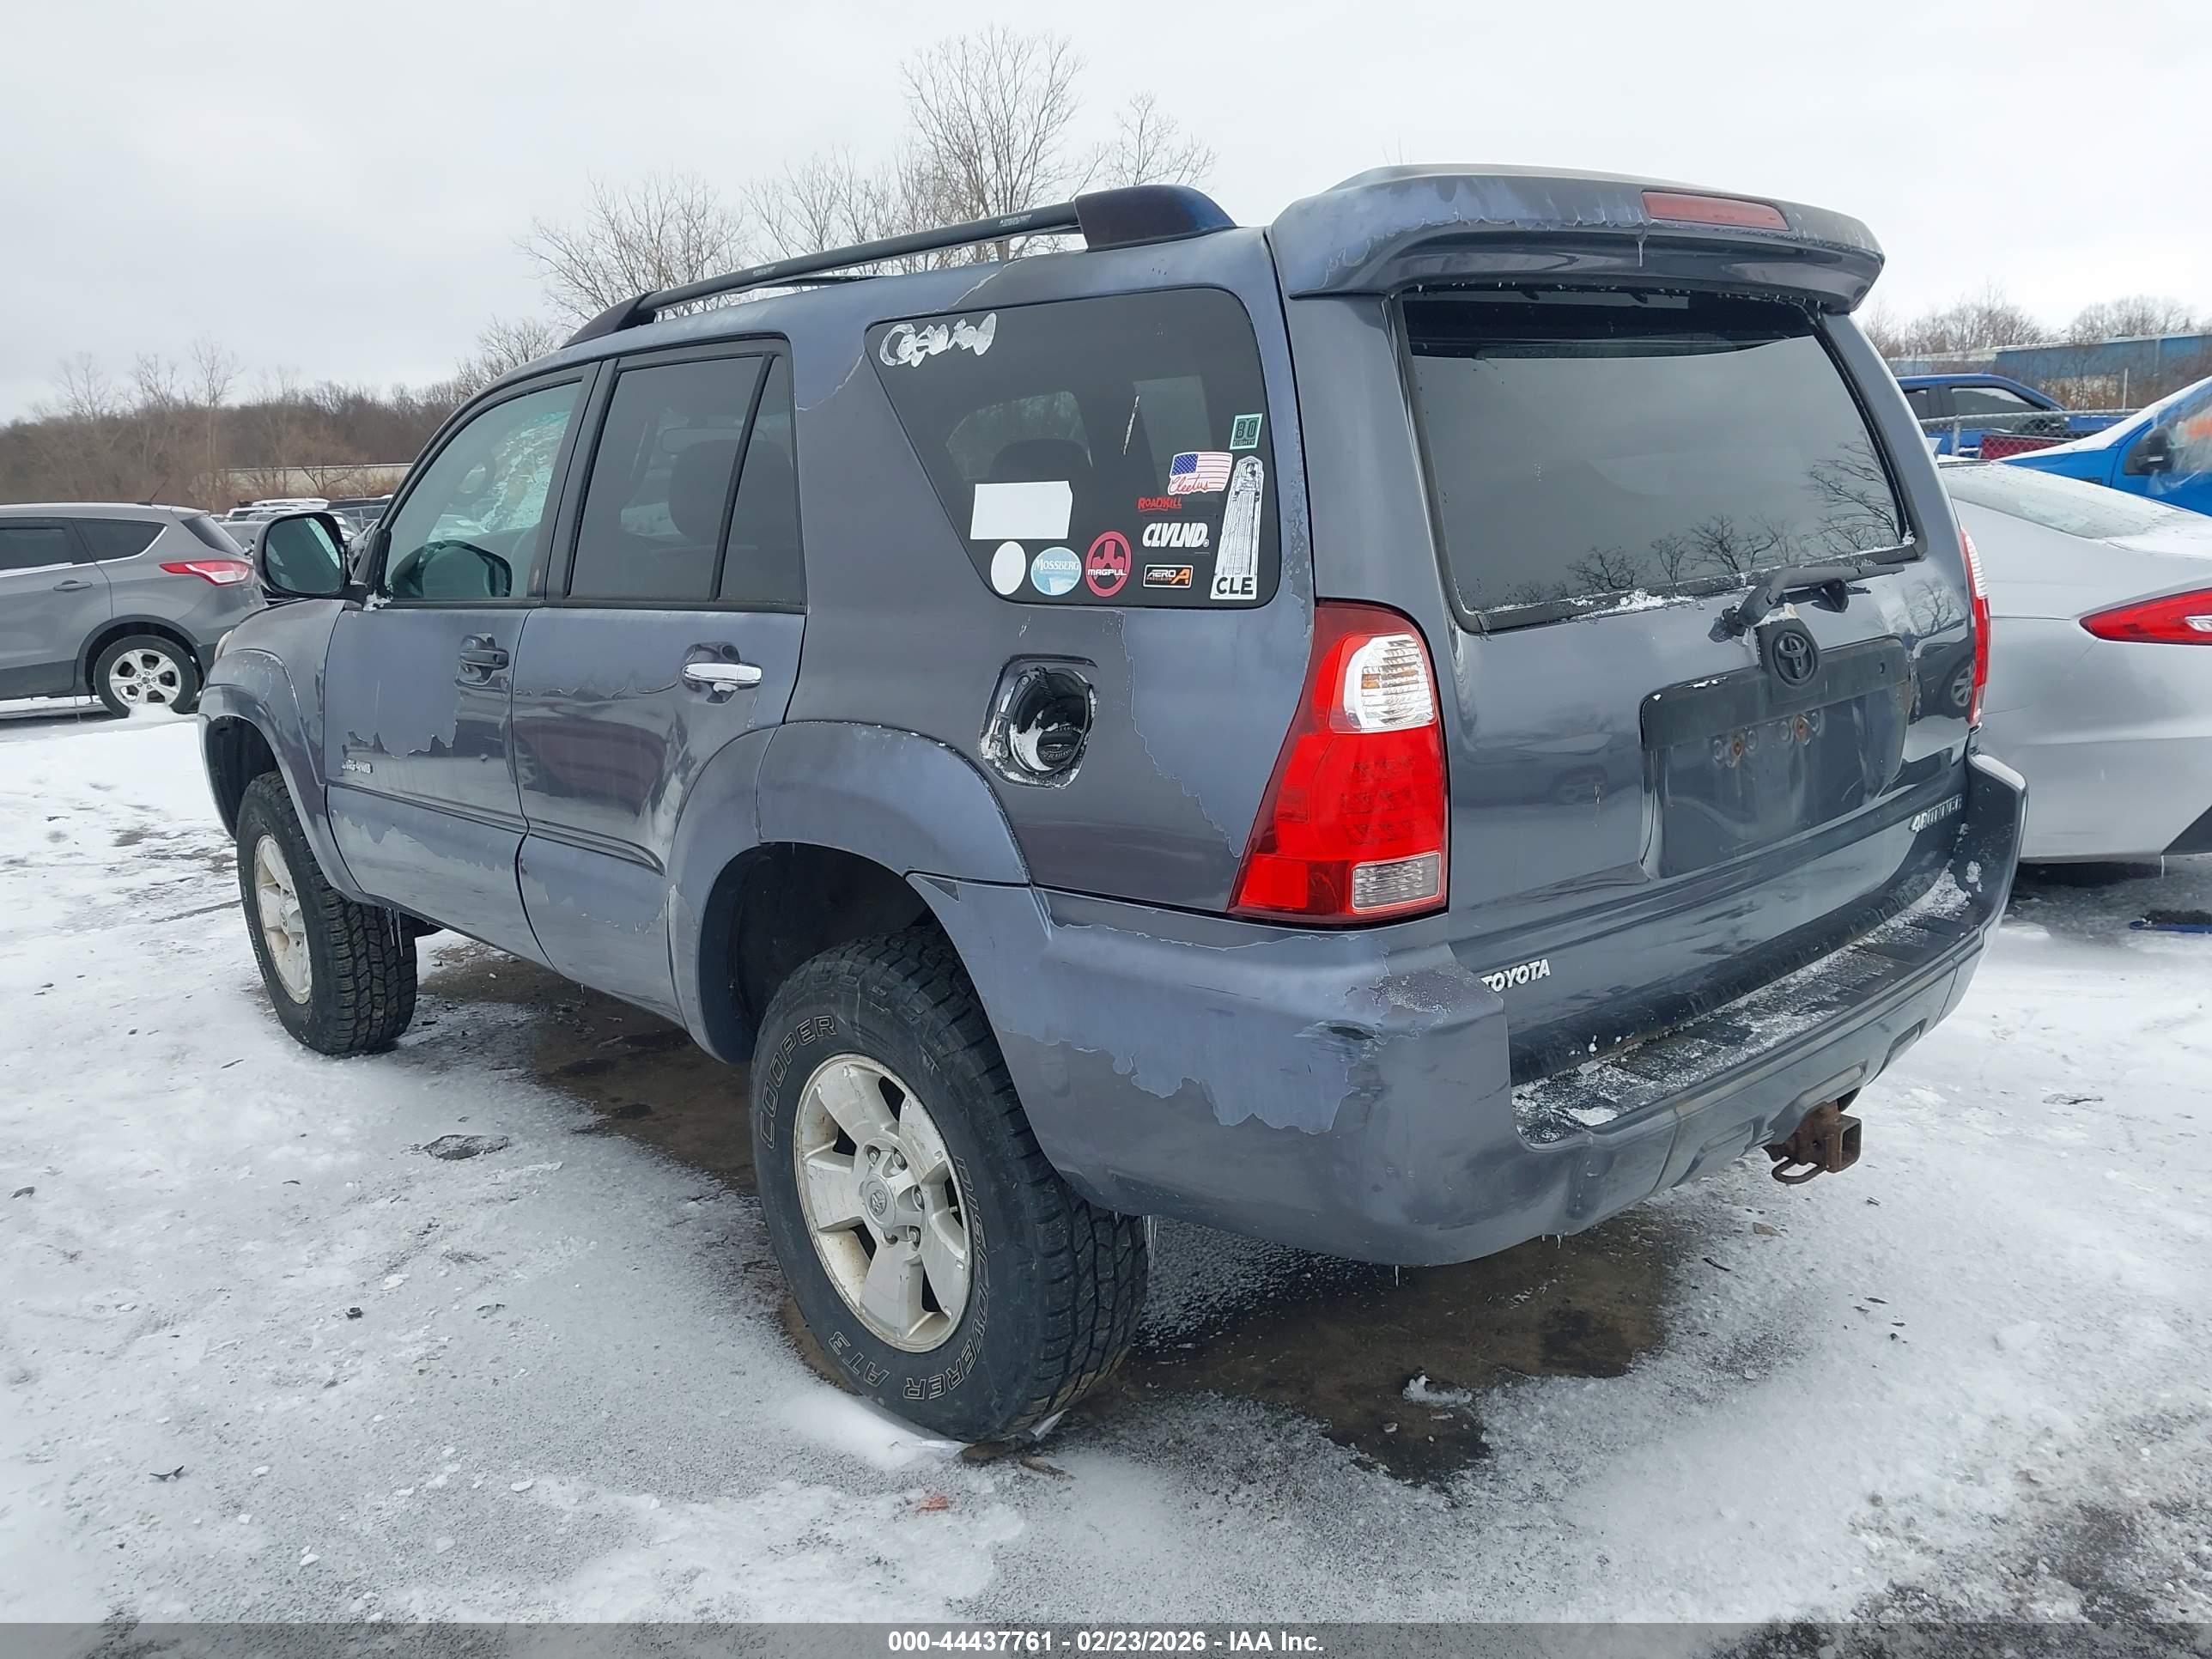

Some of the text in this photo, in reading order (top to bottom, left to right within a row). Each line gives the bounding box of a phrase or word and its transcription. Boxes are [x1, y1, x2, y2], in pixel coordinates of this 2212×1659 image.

[1235, 419, 1259, 440] 80
[1137, 496, 1182, 511] ROADKILL
[1147, 568, 1176, 578] AERO
[1216, 576, 1254, 594] CLE
[1480, 958, 1551, 992] TOYOTA
[760, 1015, 837, 1149] COOPER
[902, 1155, 989, 1401] DISCOVERER
